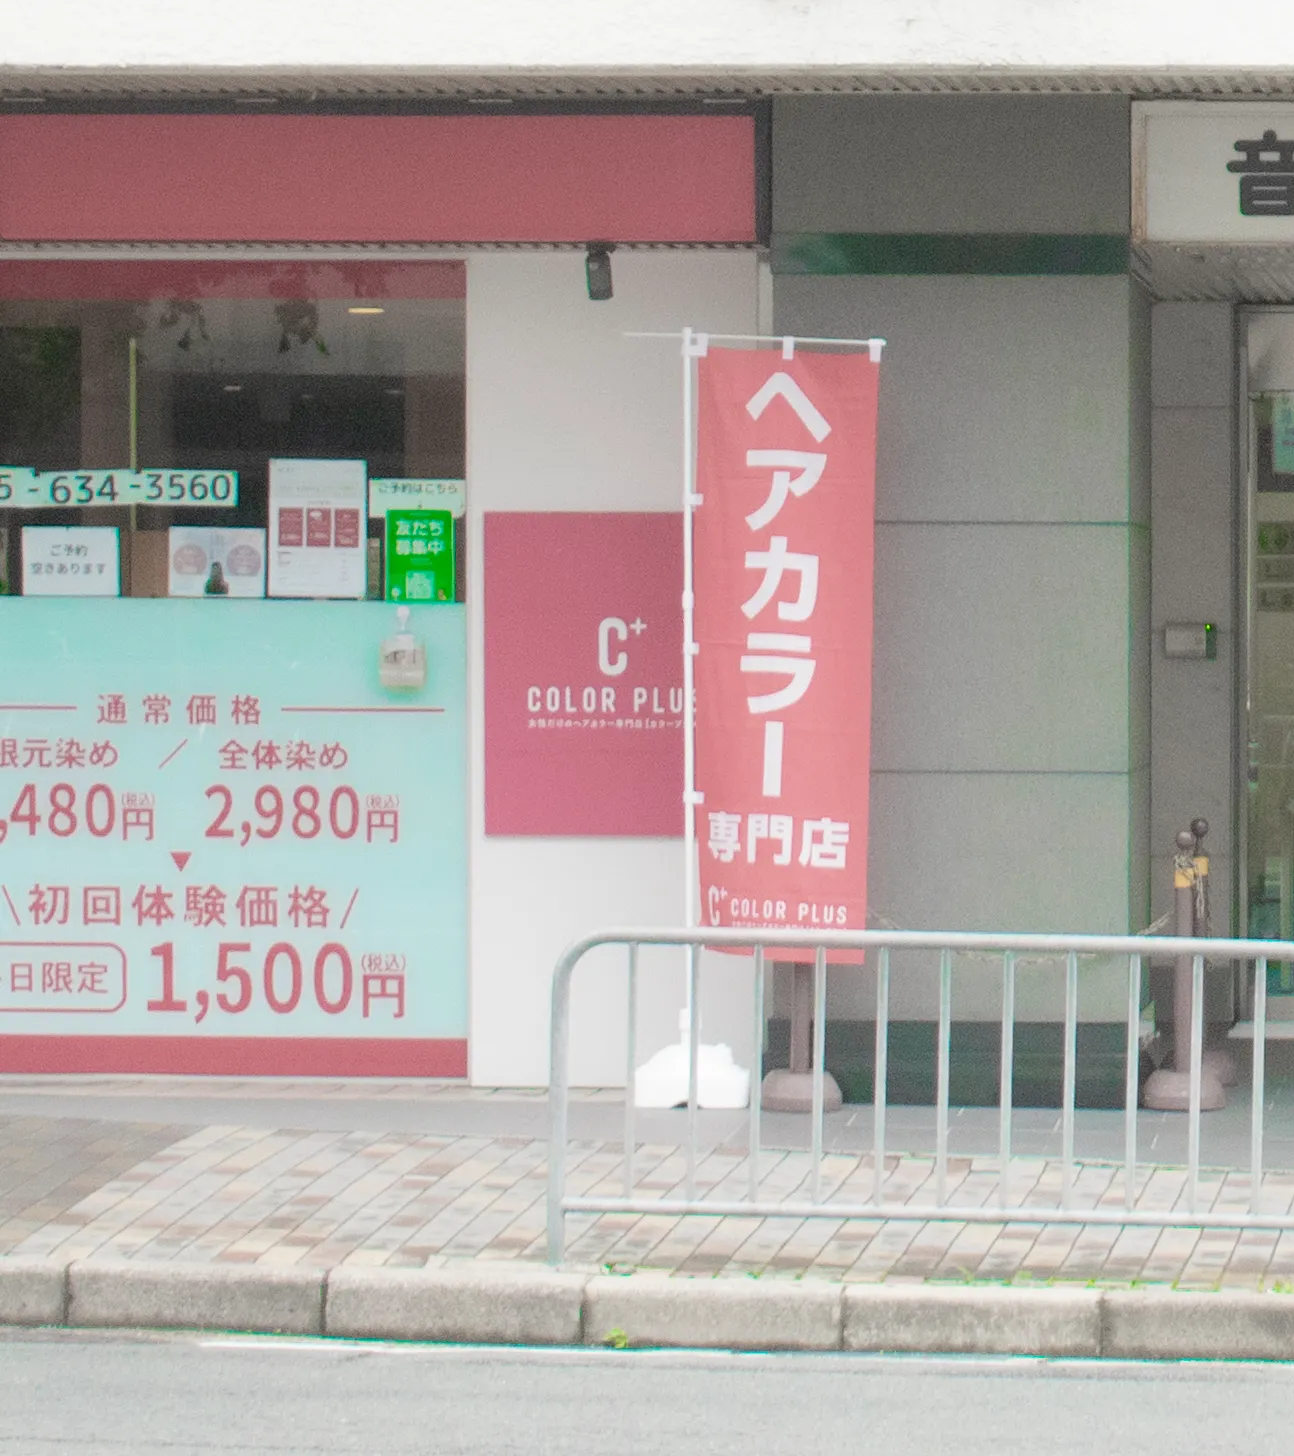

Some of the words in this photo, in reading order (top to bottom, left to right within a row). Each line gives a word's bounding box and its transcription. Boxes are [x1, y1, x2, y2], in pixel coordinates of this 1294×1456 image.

[740, 371, 832, 797] ヘアカラー
[96, 694, 262, 725] 通常価格
[527, 686, 616, 713] COLOR
[218, 739, 349, 770] 全体染め
[708, 811, 849, 869] 専門店
[28, 884, 331, 928] 初回体験価格
[731, 897, 787, 920] COLOR
[798, 903, 848, 925] PLUS
[0, 961, 109, 995] 日限定
